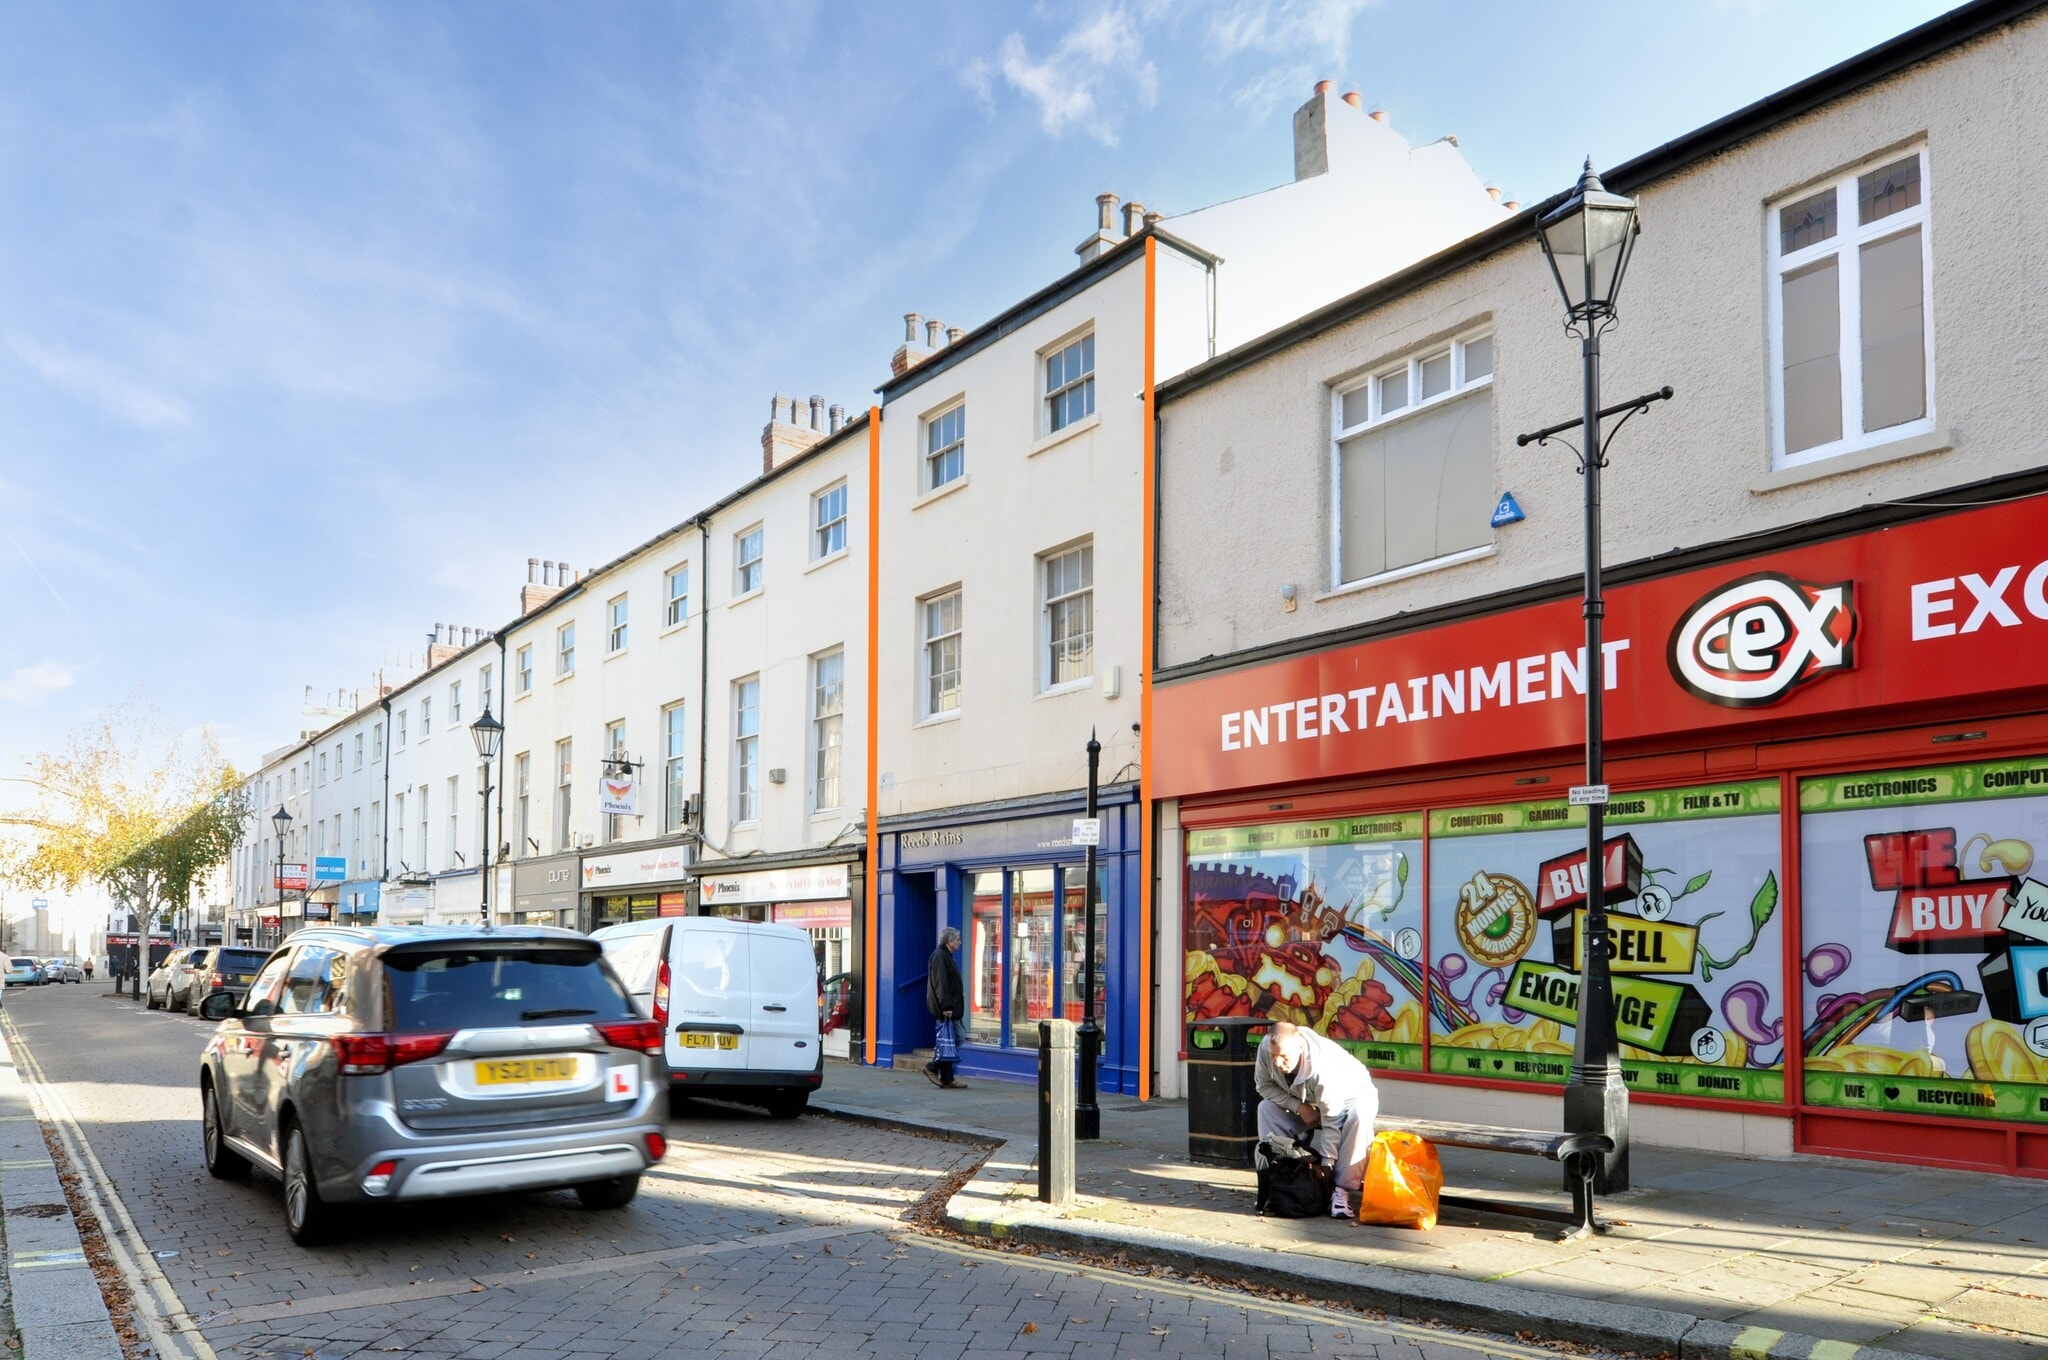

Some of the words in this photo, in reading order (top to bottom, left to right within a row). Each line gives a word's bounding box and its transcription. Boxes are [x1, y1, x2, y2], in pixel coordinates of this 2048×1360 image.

[1221, 639, 1630, 752] ENTERTAINMENT
[1843, 778, 1937, 799] ELECTRONICS
[604, 801, 632, 810] Phoenix
[1450, 813, 1503, 828] COMPUTING
[1529, 808, 1568, 822] GAMING
[1601, 800, 1646, 816] PHONES
[1684, 796, 1709, 810] FILM
[1712, 795, 1721, 807] &
[1723, 793, 1740, 807] TV
[901, 832, 929, 848] Reeds
[932, 831, 963, 847] Rains
[1037, 836, 1073, 848] www.reedsr
[1202, 836, 1228, 848] GAMING
[1248, 832, 1275, 843] PHONES
[1295, 829, 1311, 840] FILM
[1320, 827, 1330, 838] TV
[1351, 821, 1403, 836] ELECTRONICS
[1867, 830, 1959, 889] WE
[718, 880, 740, 893] Phoenix
[1461, 872, 1495, 911] 24
[1466, 889, 1518, 938] MONTHS
[1911, 894, 1988, 930] BUY
[1481, 911, 1526, 954] WARRANTY
[1519, 971, 1658, 1031] EXCHGE
[686, 1034, 711, 1045] FL71
[714, 1035, 733, 1046] UV
[1367, 1049, 1395, 1061] DONATE
[613, 1073, 631, 1093] L
[1468, 1058, 1482, 1070] WE
[1514, 1060, 1564, 1076] RECYCLING
[1656, 1072, 1680, 1085] SELL
[1697, 1074, 1740, 1091] DONATE
[1844, 1084, 1865, 1099] WE
[1917, 1089, 1996, 1108] RECYCLING
